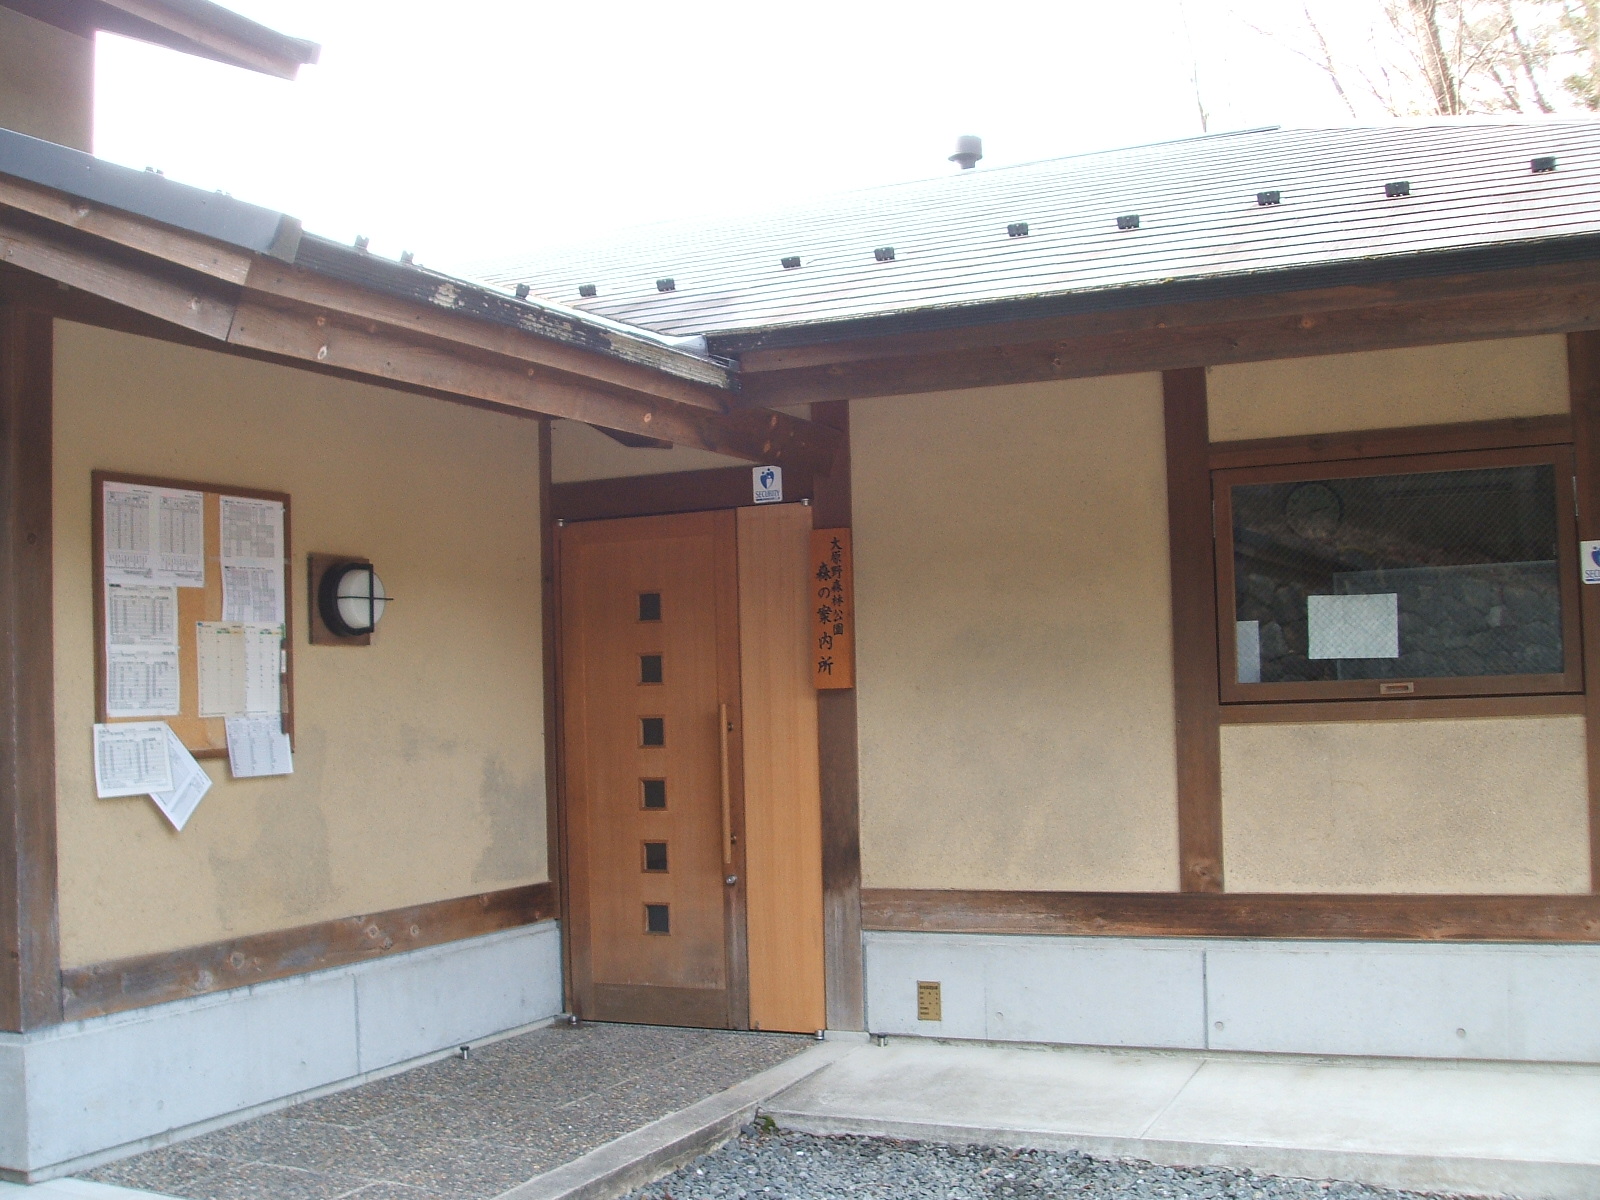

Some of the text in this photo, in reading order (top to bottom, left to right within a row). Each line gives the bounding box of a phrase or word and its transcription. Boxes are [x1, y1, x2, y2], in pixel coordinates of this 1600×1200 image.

[755, 490, 780, 499] SECURITY
[816, 561, 834, 676] 森の案内所
